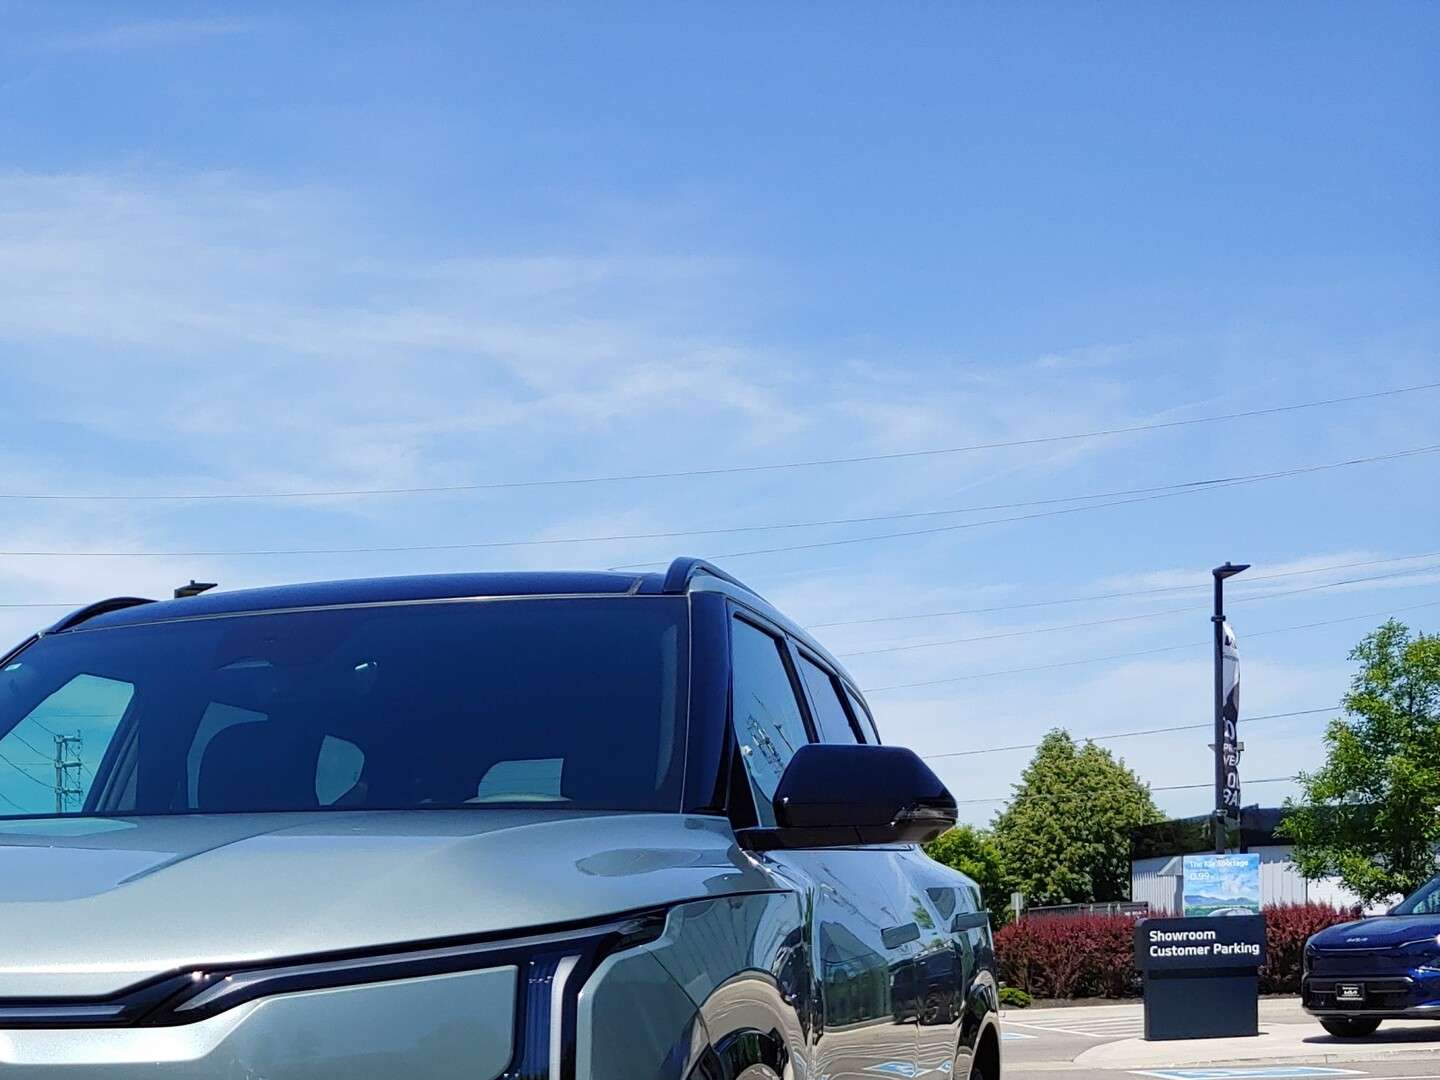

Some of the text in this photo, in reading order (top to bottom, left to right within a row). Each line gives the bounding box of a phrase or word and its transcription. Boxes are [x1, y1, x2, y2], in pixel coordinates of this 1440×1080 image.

[1149, 930, 1216, 942] Showroom
[1149, 942, 1260, 957] Customer Parking
